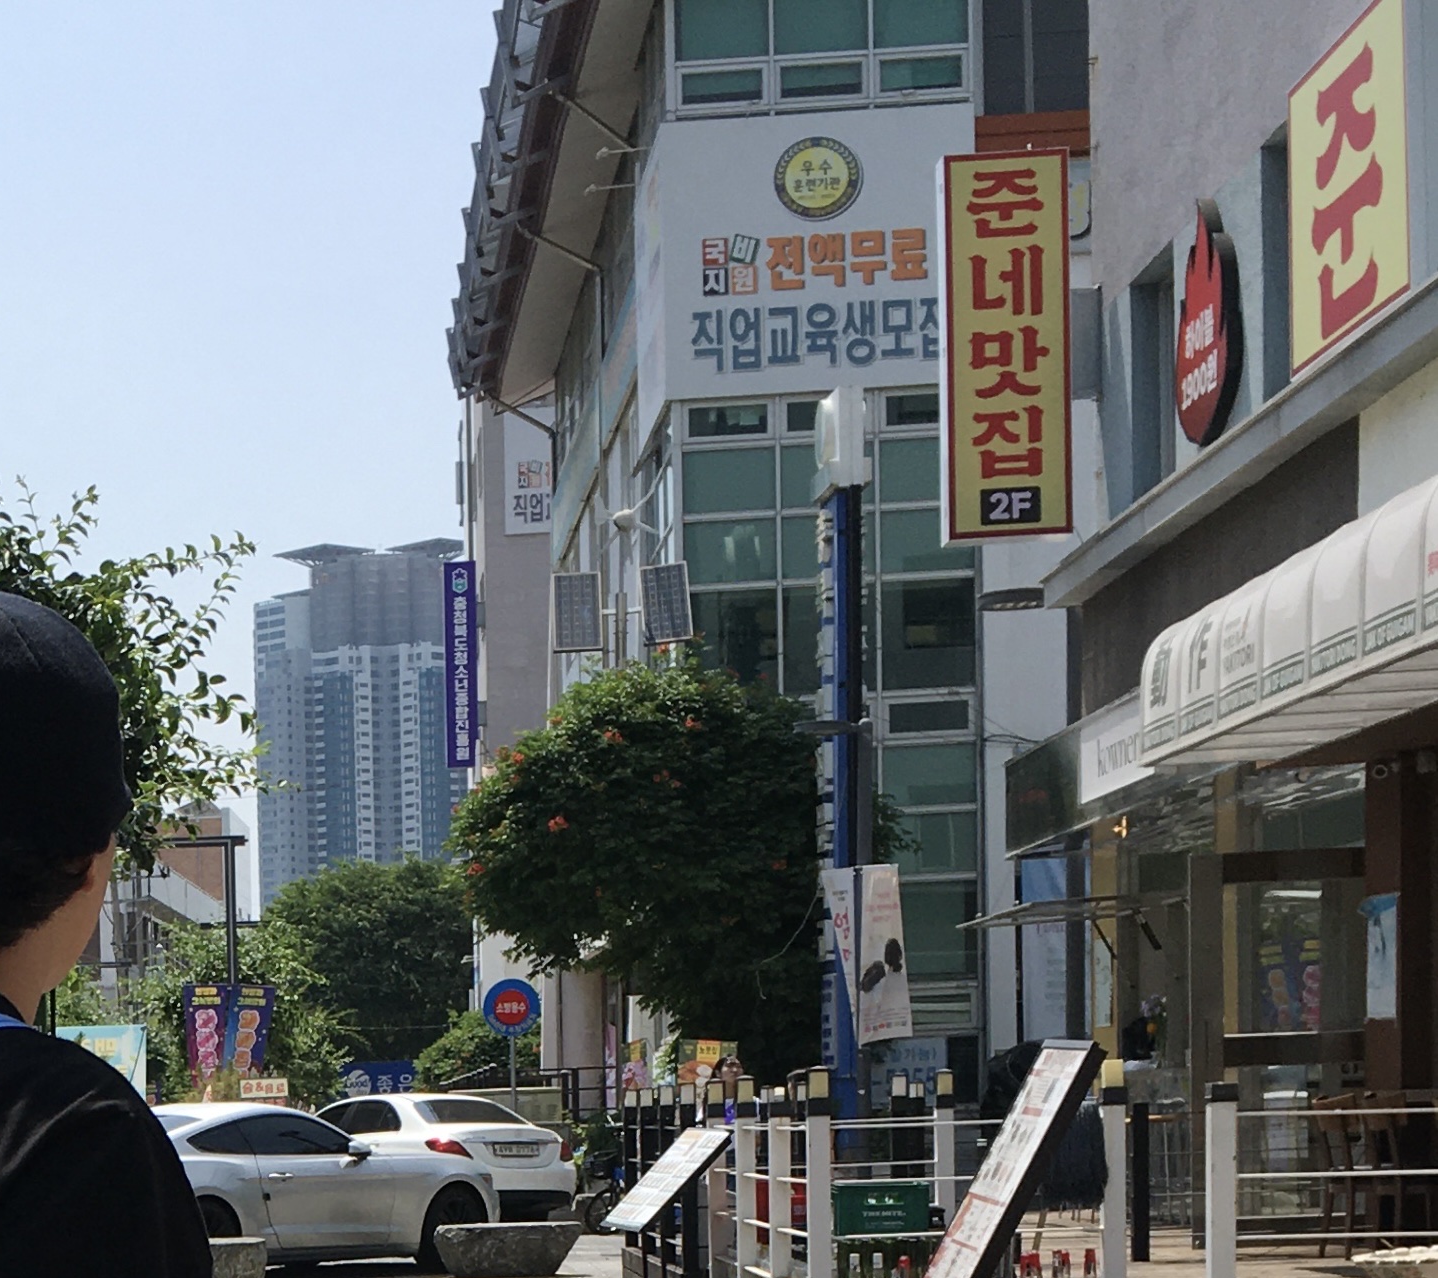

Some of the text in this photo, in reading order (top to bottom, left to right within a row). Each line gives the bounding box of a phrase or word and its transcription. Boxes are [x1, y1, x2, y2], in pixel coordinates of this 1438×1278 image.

[1312, 41, 1384, 341] 준
[766, 228, 929, 292] 전액무료
[966, 167, 1051, 480] 준네맛집
[1181, 347, 1219, 411] 1900원
[988, 490, 1033, 521] 2F
